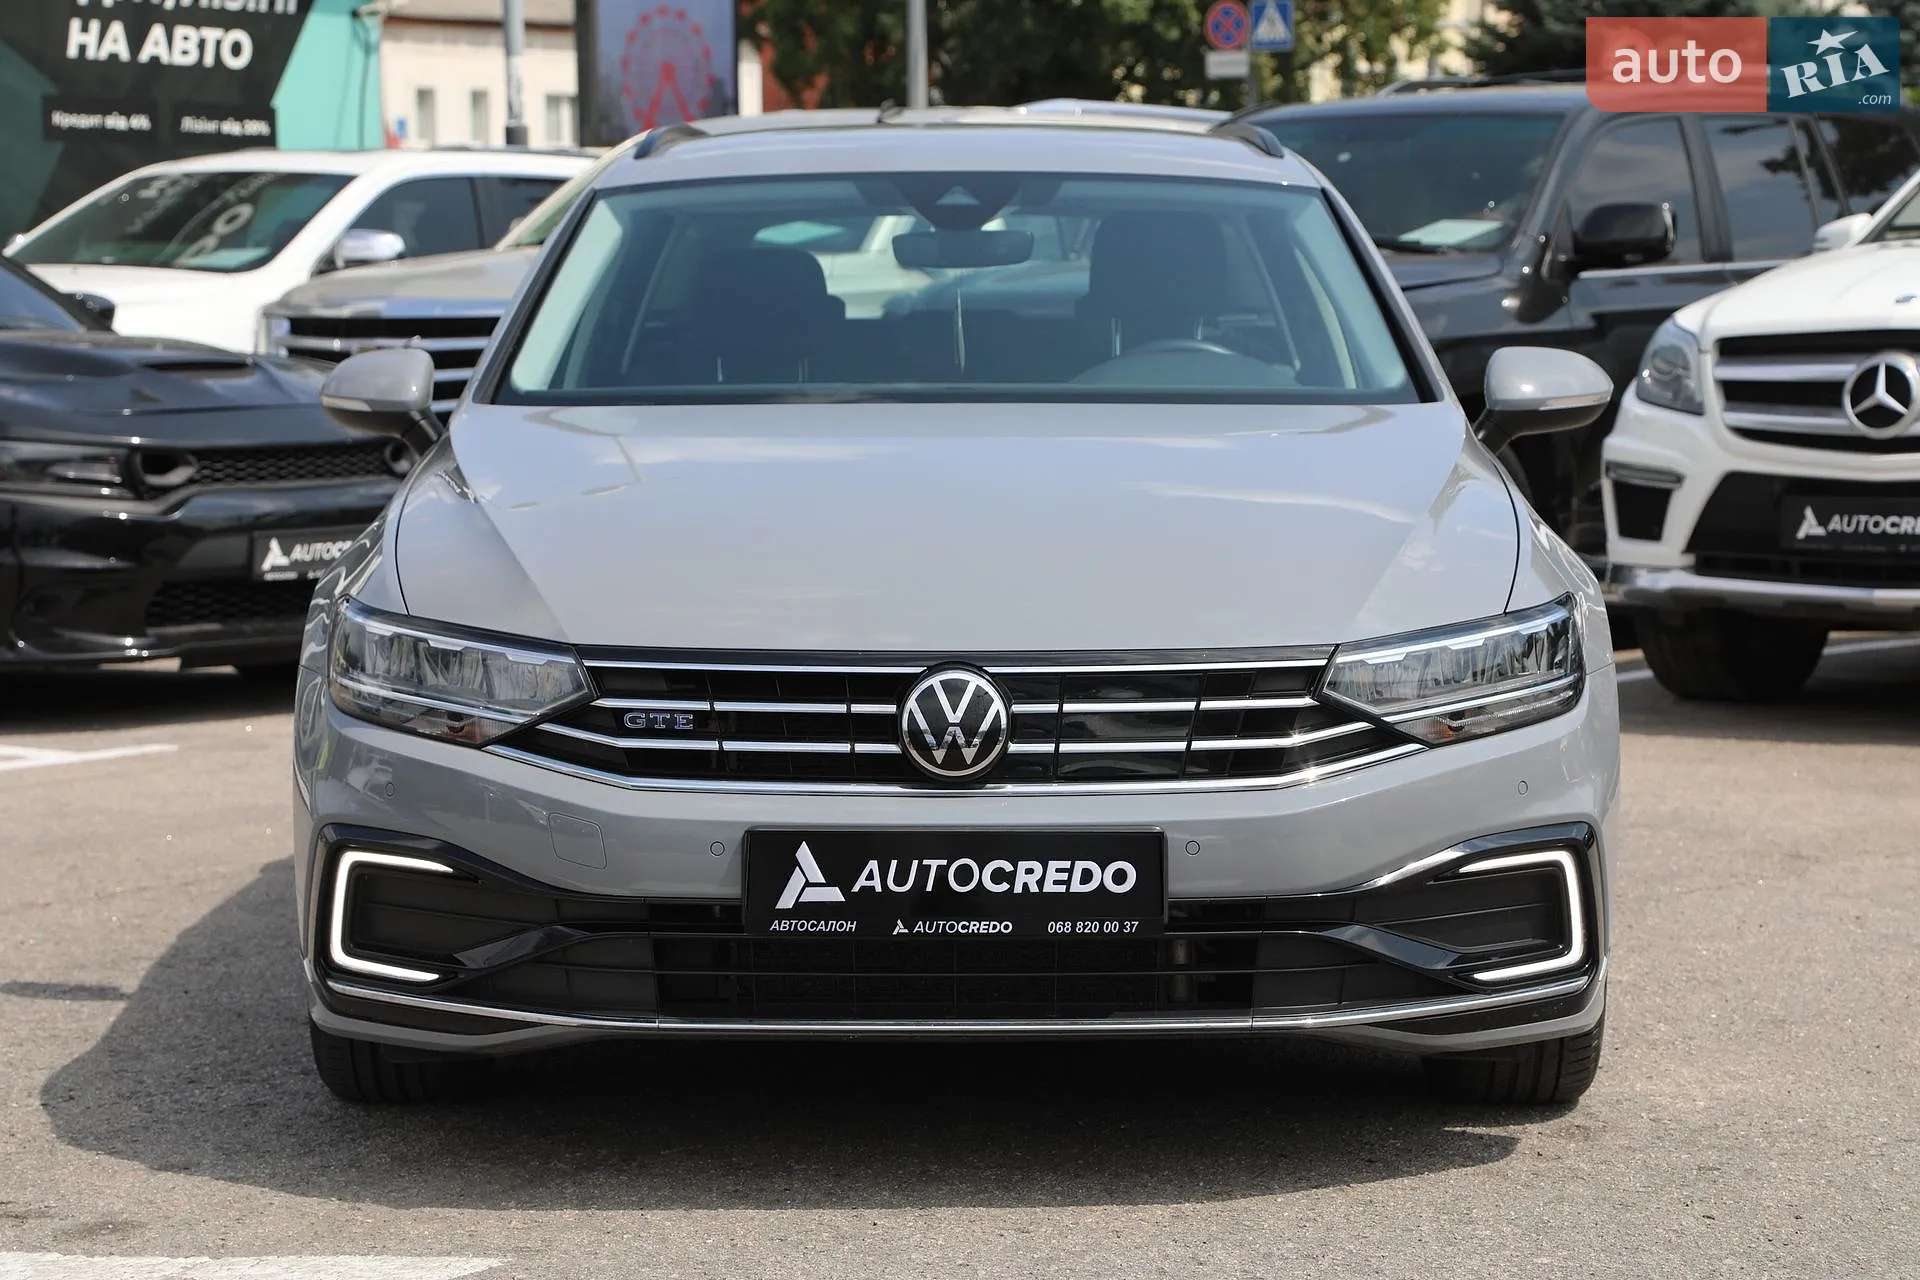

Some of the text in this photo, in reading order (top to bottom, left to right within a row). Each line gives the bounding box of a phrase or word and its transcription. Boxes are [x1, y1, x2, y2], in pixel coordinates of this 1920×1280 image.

[66, 17, 253, 70] НА АВТО
[290, 540, 353, 561] AUTOC
[624, 712, 693, 729] GTE
[851, 858, 1137, 894] AUTOCREDO
[770, 920, 857, 932] АВТОСАЛОН
[913, 920, 1013, 934] AUTOCREDO
[1047, 921, 1139, 934] 068 820 00 37
